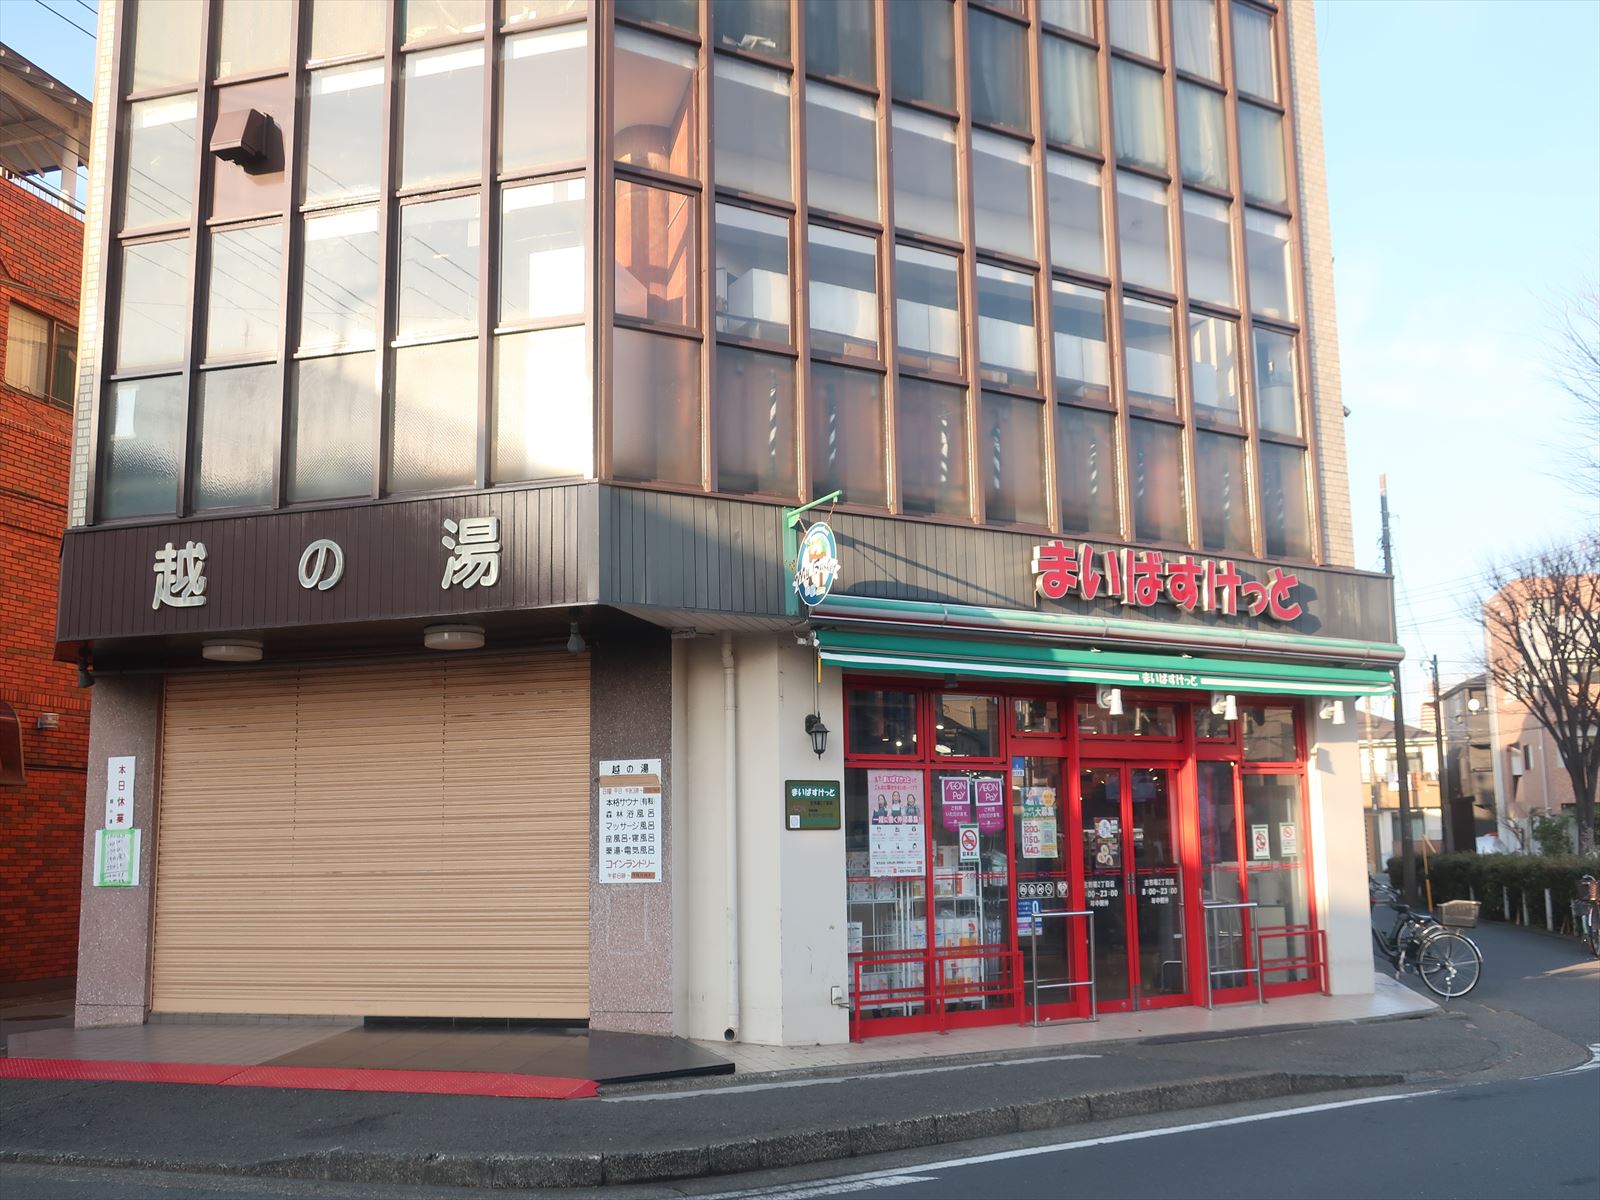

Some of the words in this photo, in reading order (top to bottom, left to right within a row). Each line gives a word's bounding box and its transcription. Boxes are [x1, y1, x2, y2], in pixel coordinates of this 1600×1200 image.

[152, 517, 501, 610] 越の湯
[1031, 540, 1303, 622] まいばすけっと
[1142, 671, 1199, 687] まいばすけっと
[612, 763, 649, 774] 越の湯
[791, 788, 836, 797] まいばすけっと
[606, 808, 655, 819] 森林浴風呂
[605, 821, 655, 831] マッサージ風呂
[605, 859, 656, 869] コインランドリー
